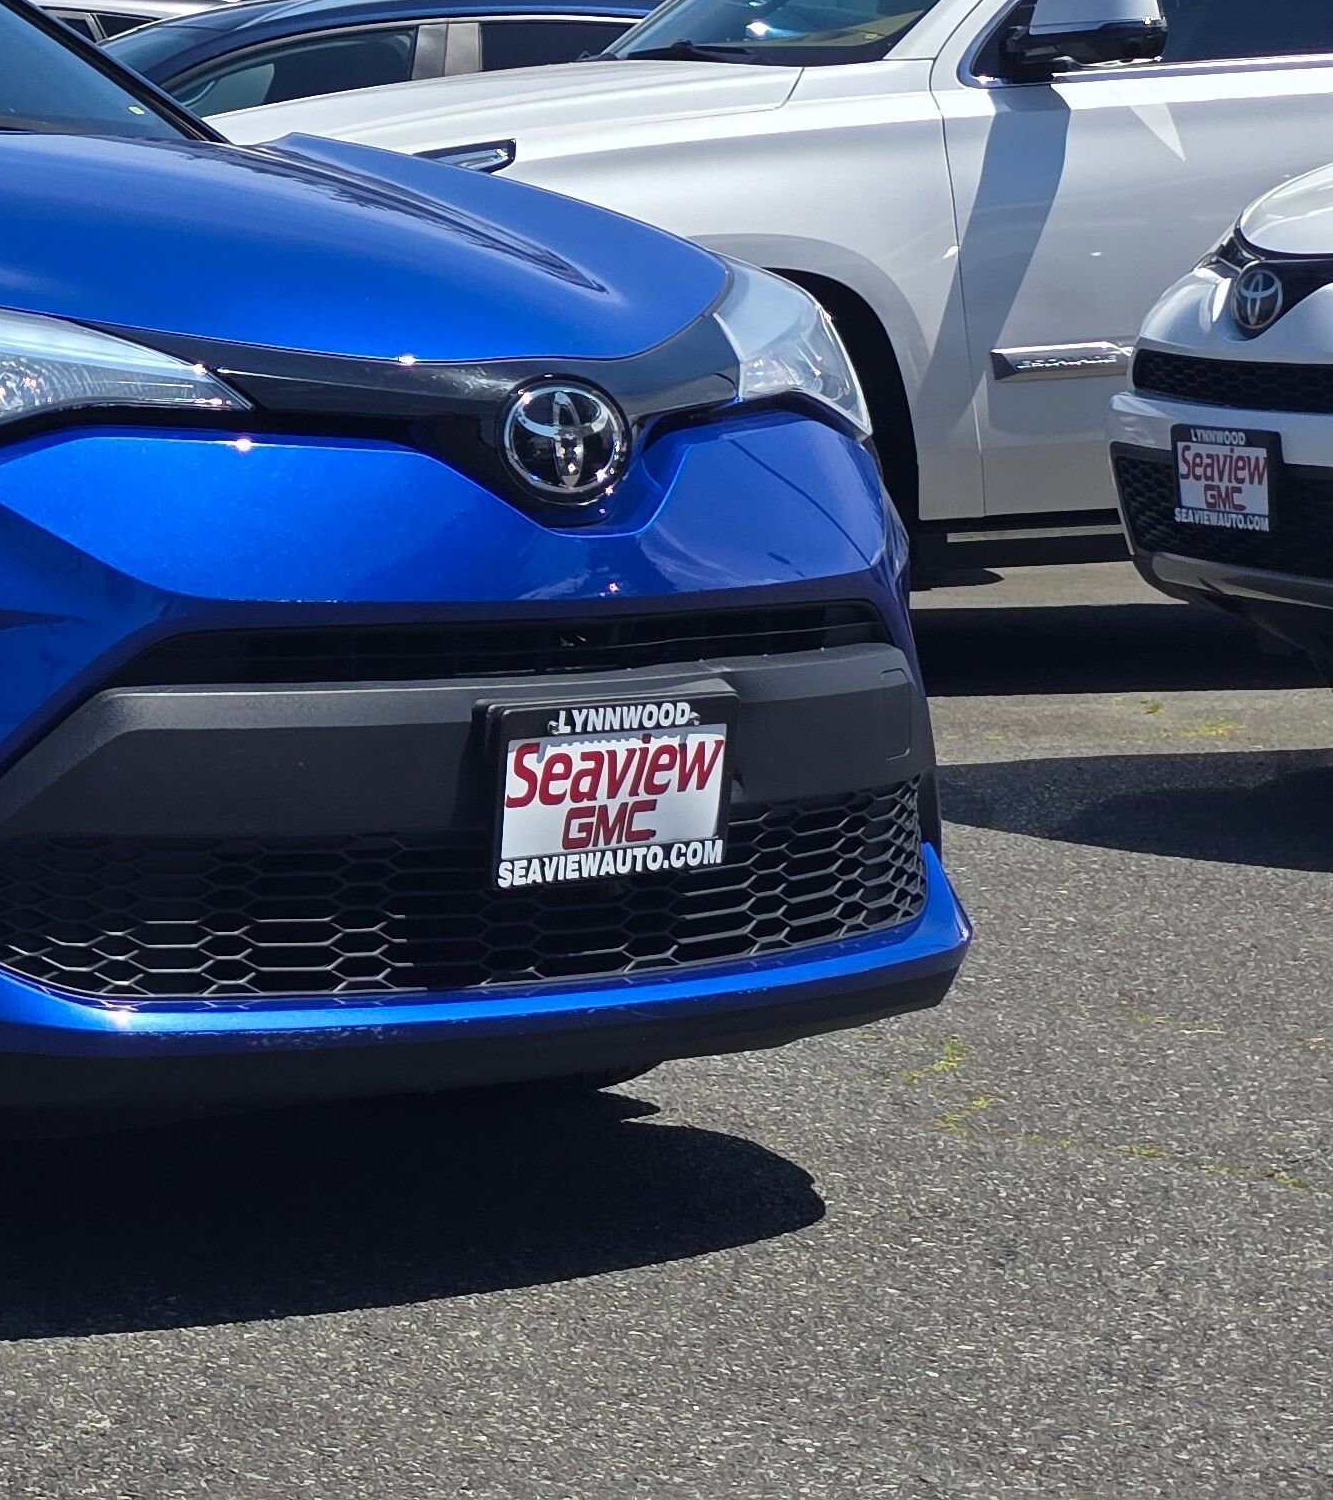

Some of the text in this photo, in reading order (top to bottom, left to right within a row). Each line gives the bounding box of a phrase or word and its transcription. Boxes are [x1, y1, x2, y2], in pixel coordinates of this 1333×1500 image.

[1190, 428, 1246, 445] LYNNWOOD
[1180, 444, 1268, 486] Seaview
[1203, 483, 1247, 512] GMC
[1174, 507, 1269, 531] SEAVIEWAUTO.COM
[557, 702, 692, 735] LYNNWOOD
[505, 733, 725, 808] Seaview
[561, 798, 658, 851] GMC
[497, 839, 724, 888] SEAVIEWAUTO.COM
